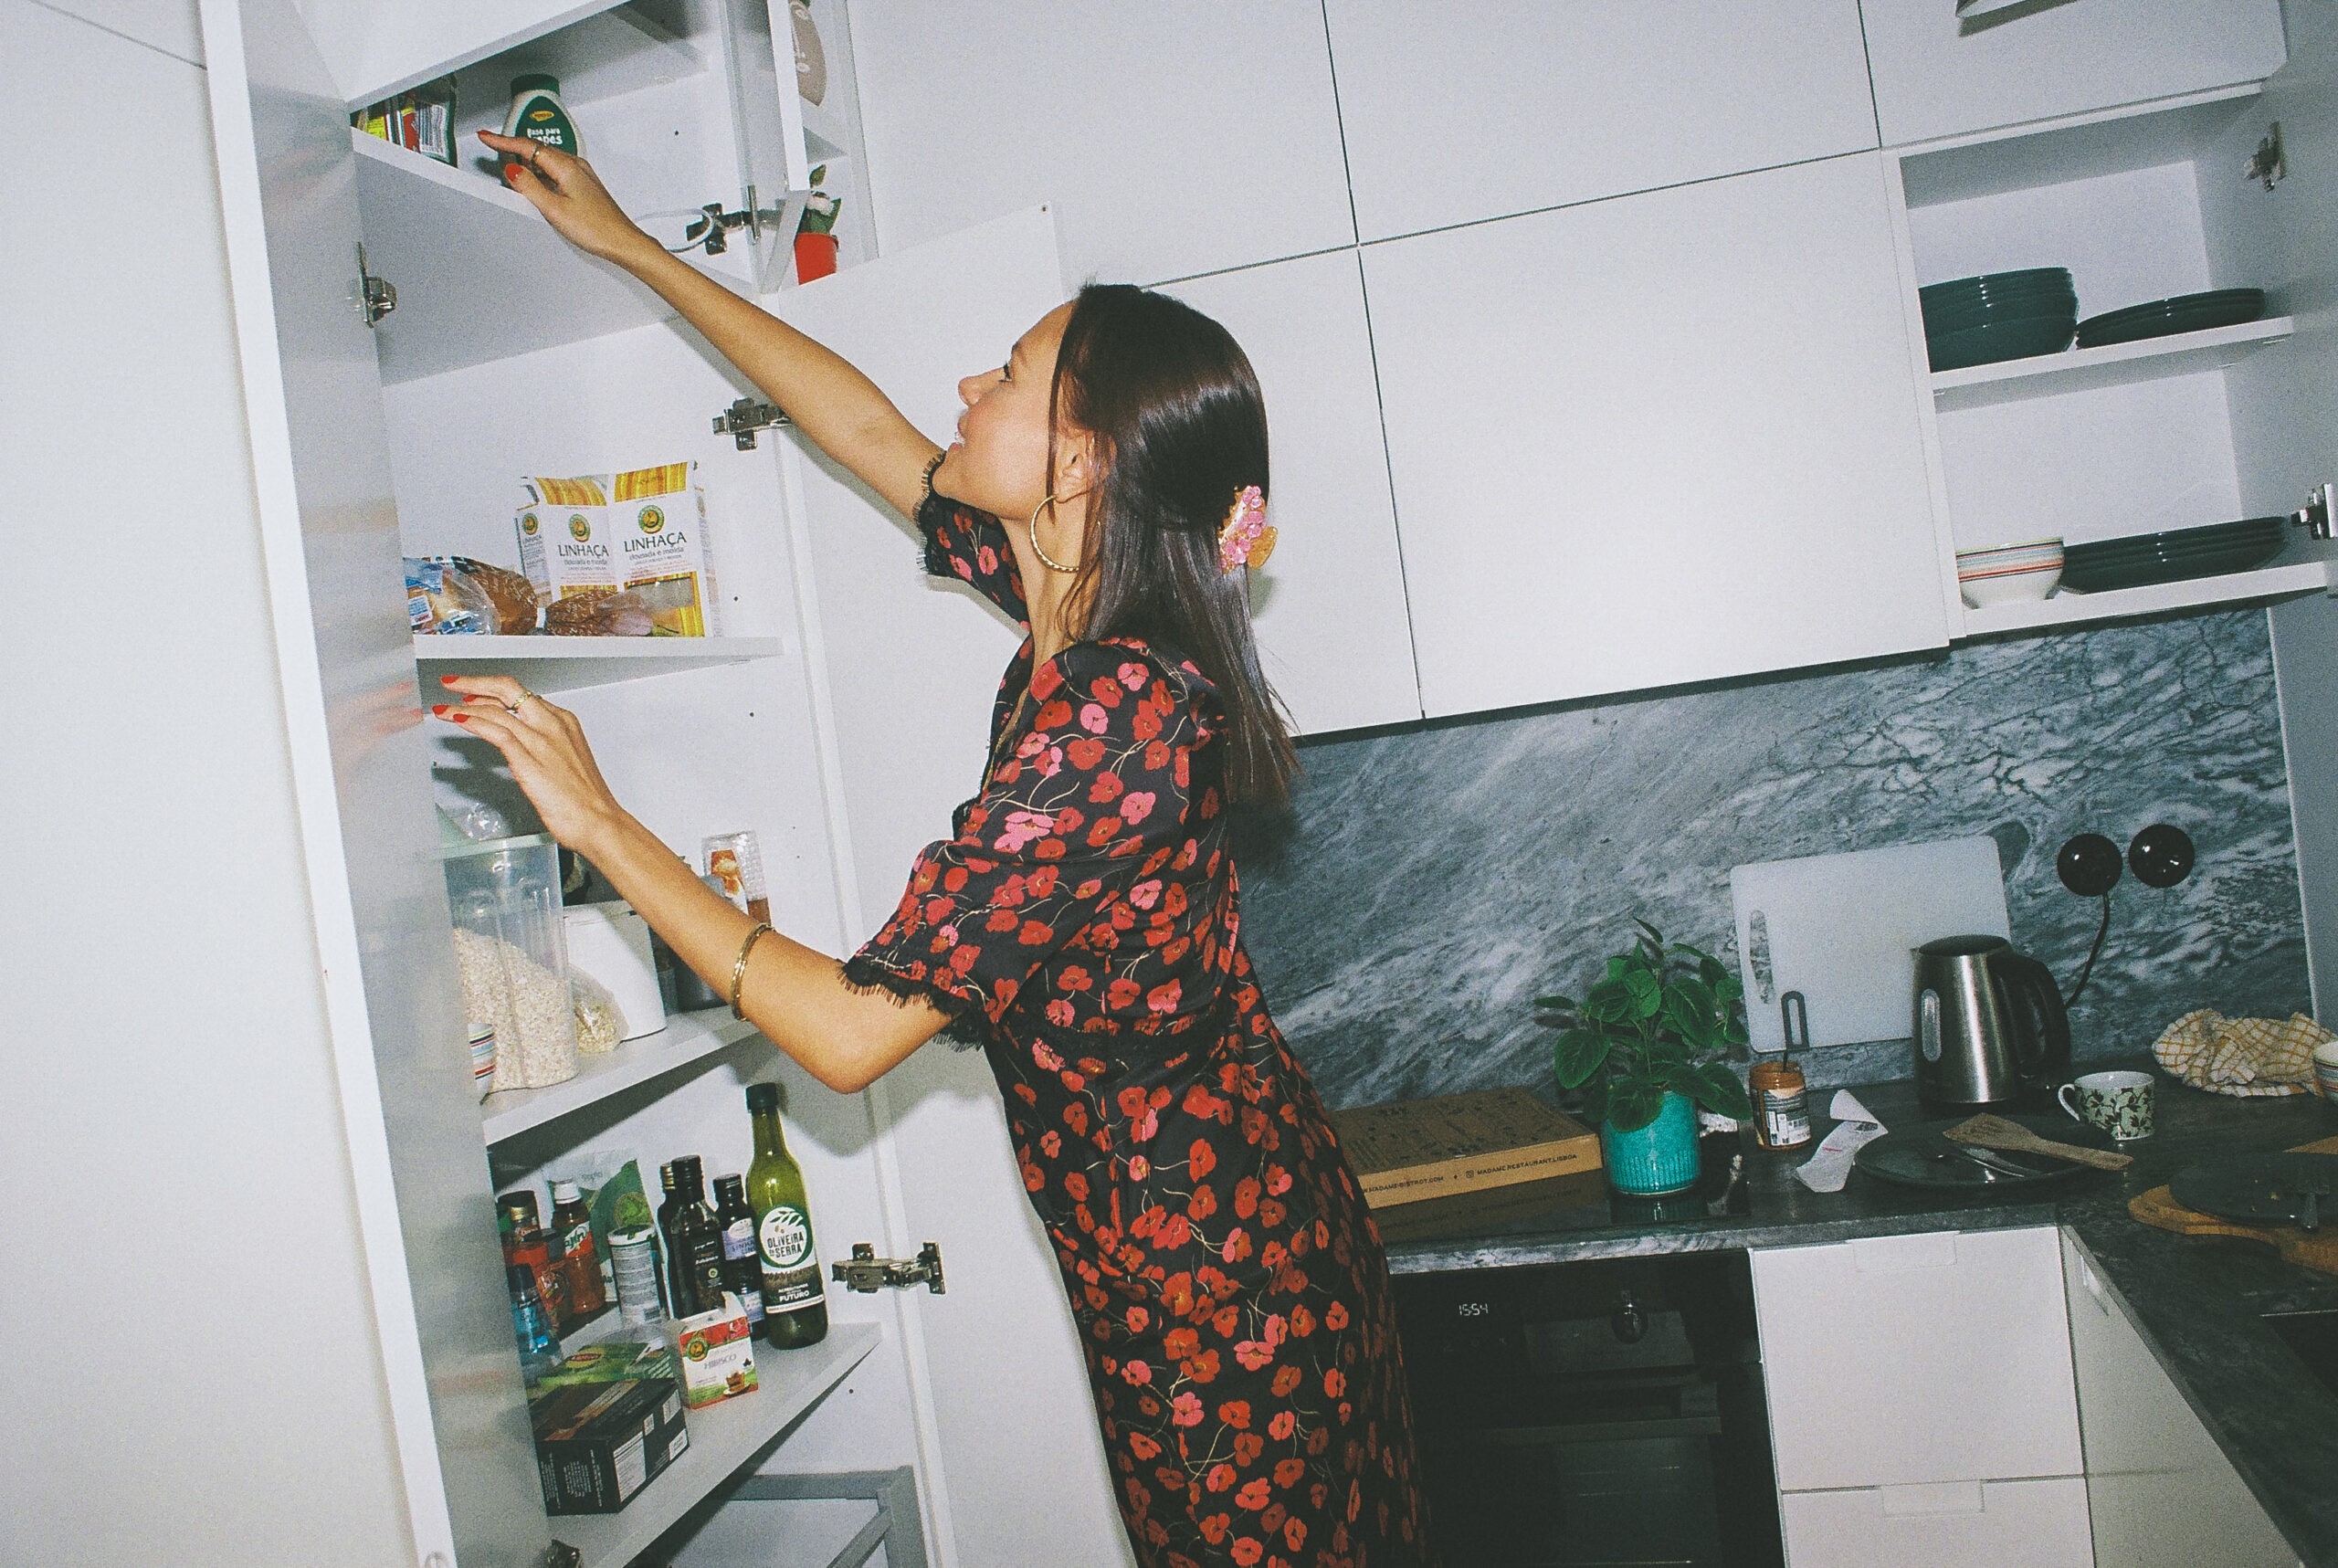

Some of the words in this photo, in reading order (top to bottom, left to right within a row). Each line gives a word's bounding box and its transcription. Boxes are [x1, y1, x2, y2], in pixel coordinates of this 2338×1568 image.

[624, 531, 687, 552] LINHAÇA
[557, 544, 609, 559] LINHAÇA
[775, 1244, 802, 1258] SERRA
[779, 1289, 810, 1302] FUTURO
